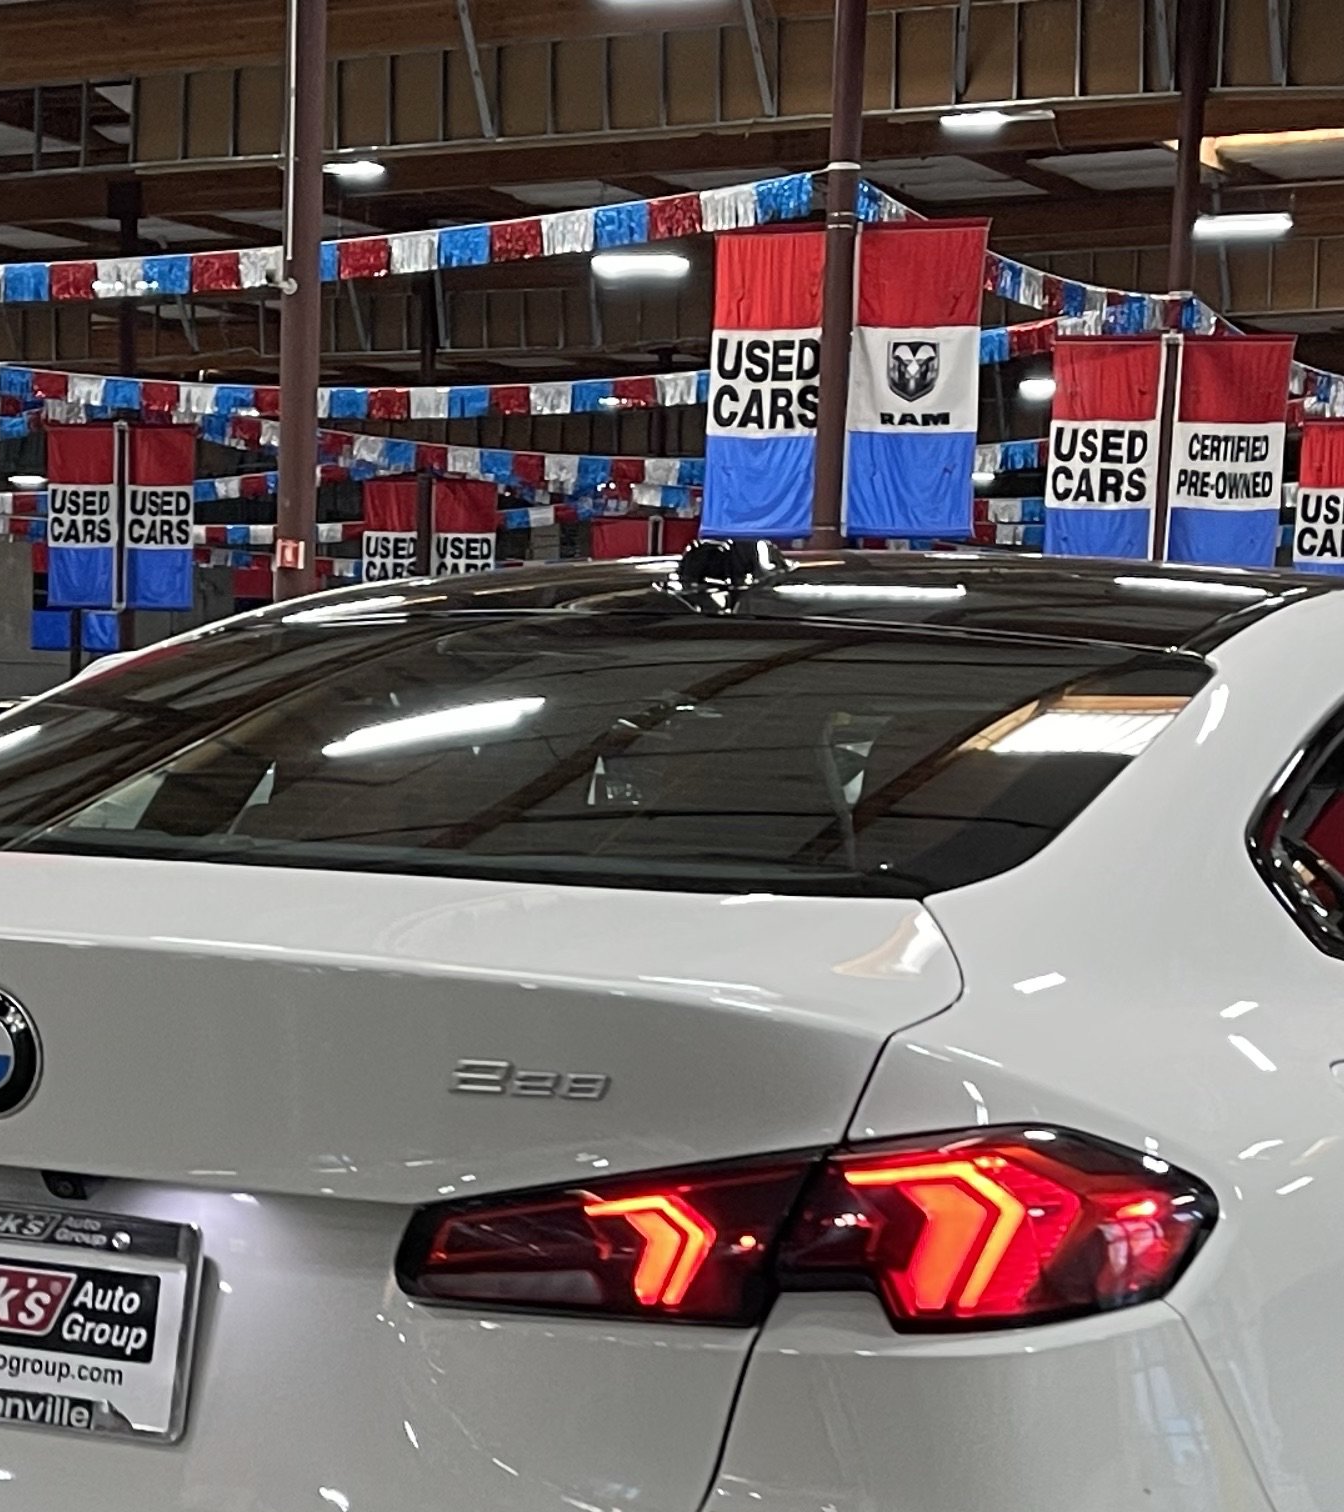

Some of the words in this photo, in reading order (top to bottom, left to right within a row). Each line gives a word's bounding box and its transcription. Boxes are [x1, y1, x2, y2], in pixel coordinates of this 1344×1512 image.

[717, 338, 821, 382] USED
[713, 385, 819, 429] CARS
[880, 412, 950, 426] RAM
[1054, 427, 1148, 464] USED
[1188, 433, 1269, 463] CERTIFIED
[1052, 466, 1147, 502] CARS
[1177, 469, 1273, 499] PRE-OWNED
[50, 489, 110, 516] USED
[130, 490, 190, 516] USED
[50, 517, 111, 543] CARS
[128, 519, 190, 545] CARS
[366, 536, 416, 560] USED
[437, 536, 492, 560] USED
[54, 1227, 107, 1246] Group
[62, 1216, 102, 1231] Auto
[73, 1281, 140, 1315] Auto
[62, 1312, 148, 1355] Group
